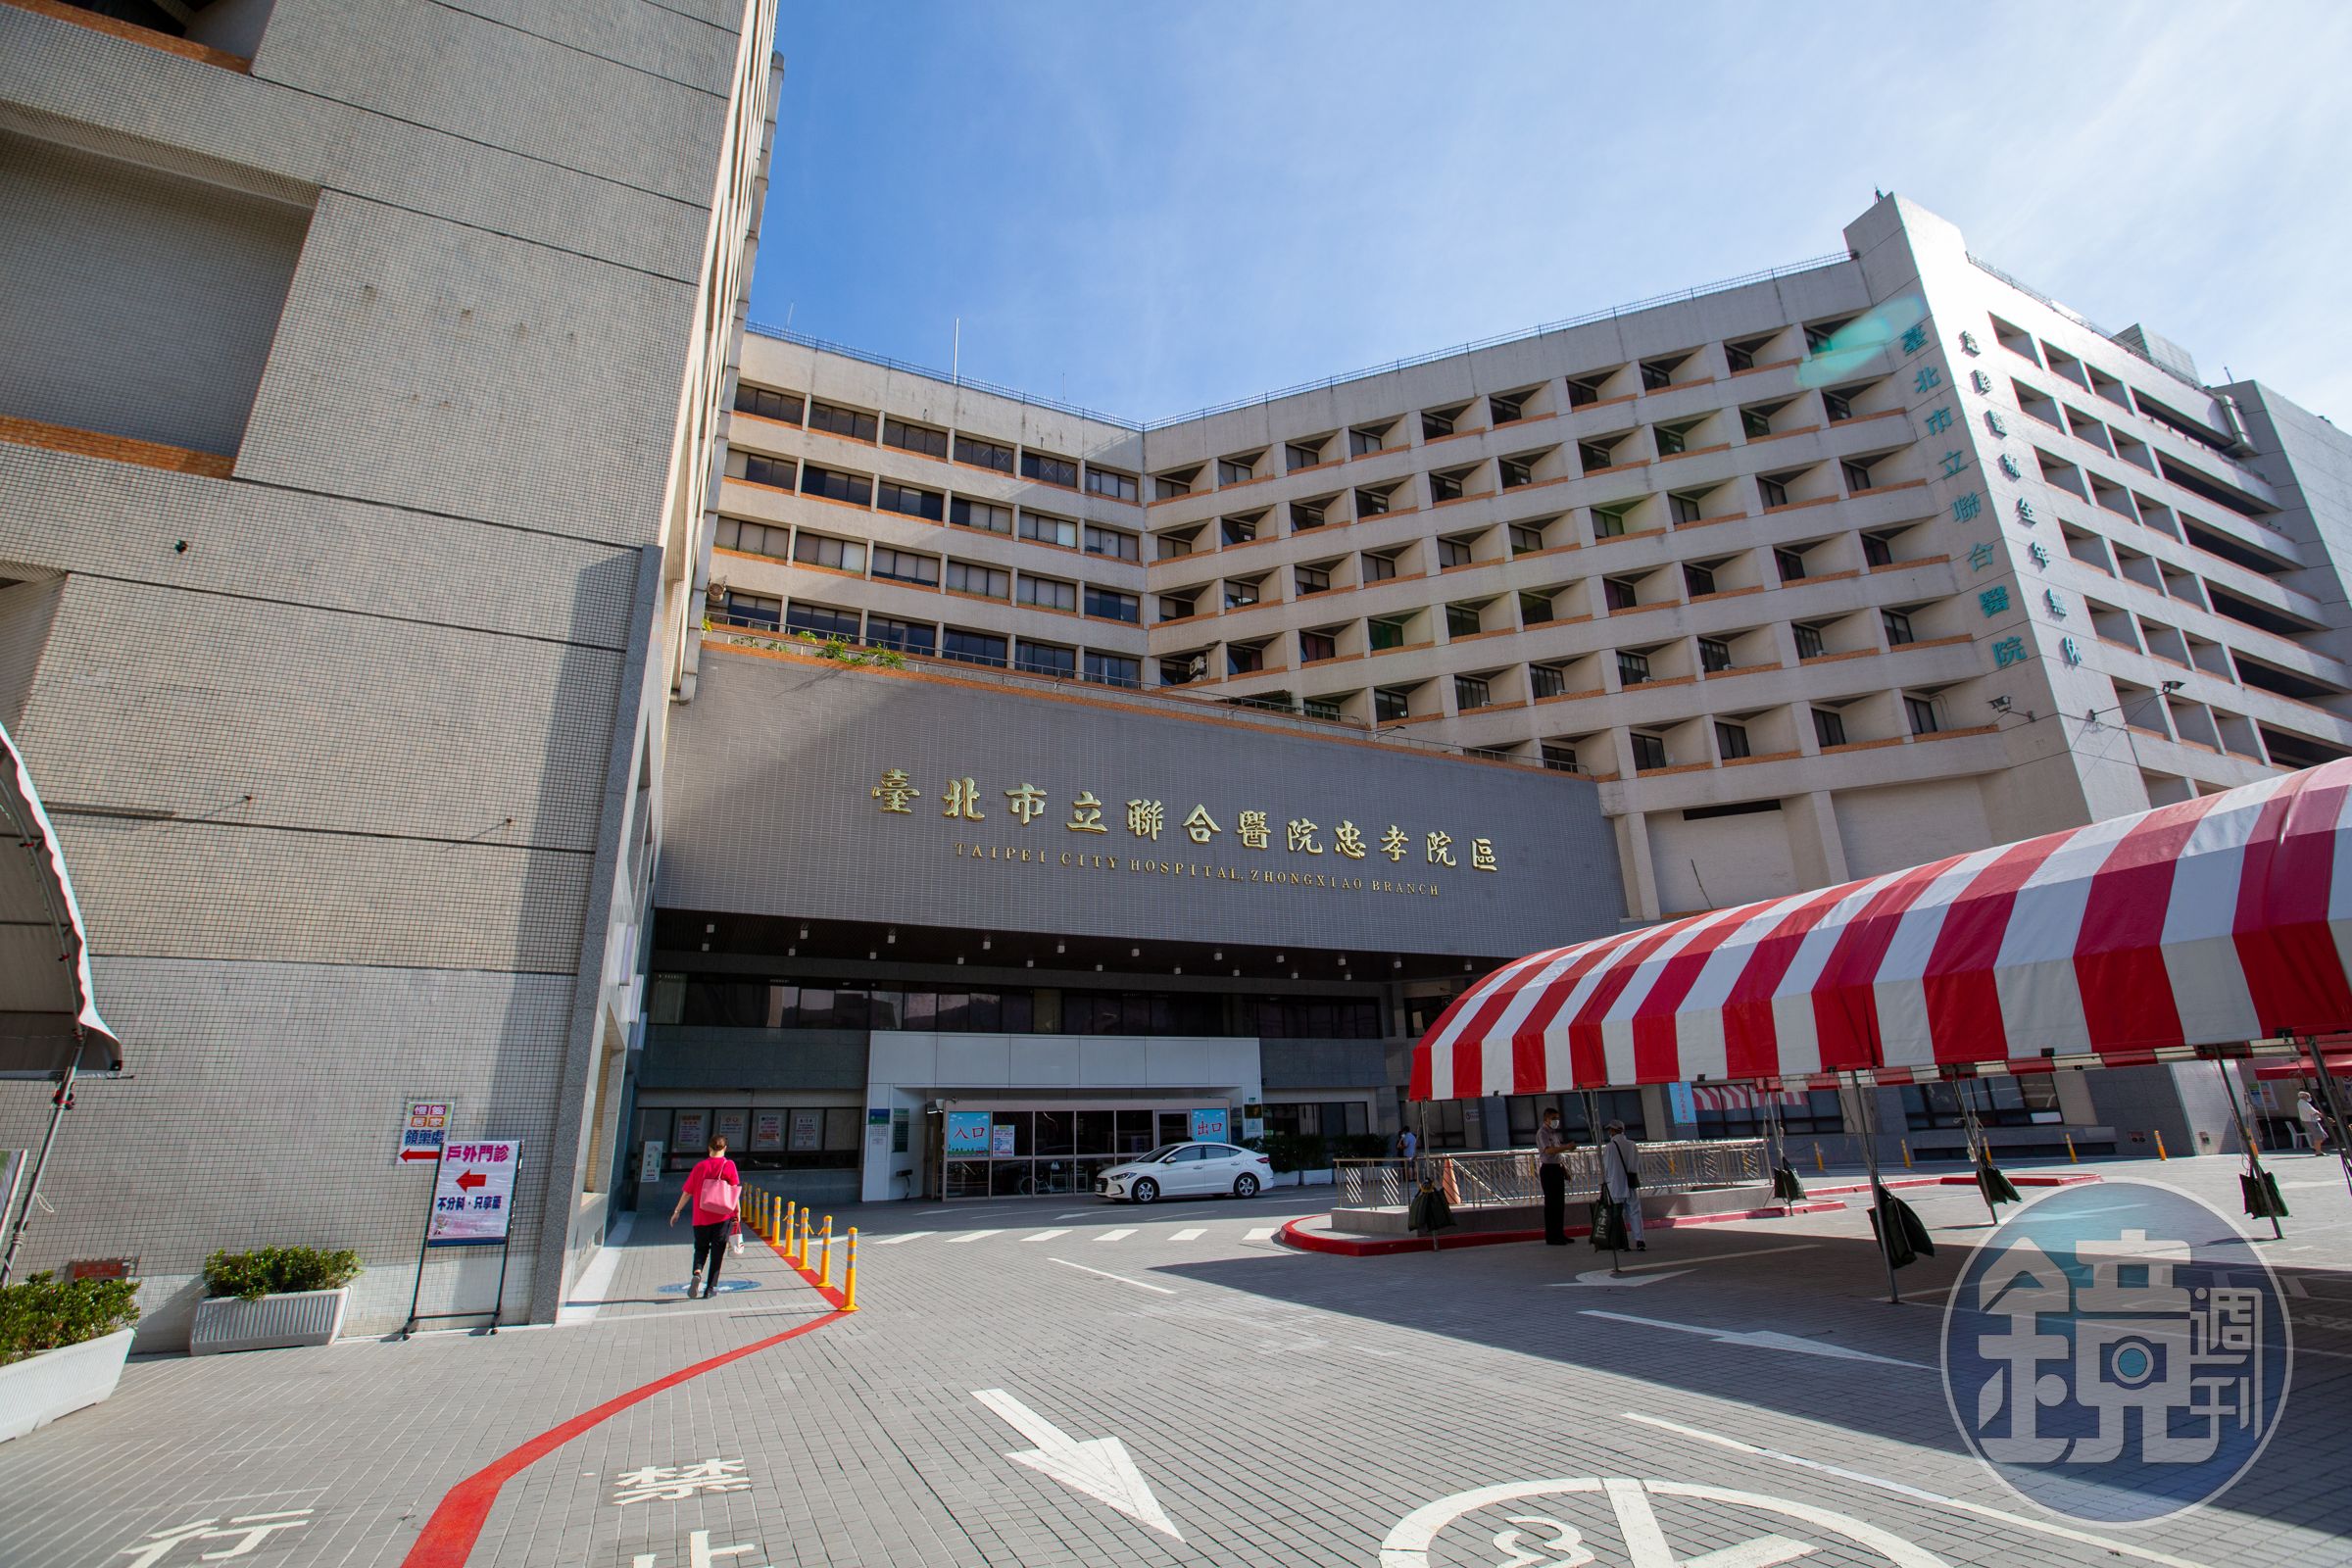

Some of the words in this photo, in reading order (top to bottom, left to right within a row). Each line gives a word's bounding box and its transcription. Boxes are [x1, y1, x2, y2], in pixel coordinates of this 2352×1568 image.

[1901, 324, 2028, 669] 臺北市立聯合醫院
[871, 767, 1497, 872] 臺北市立聯合醫院忠孝院區
[955, 843, 1046, 863] TAIPEI
[1060, 853, 1118, 870] CITY
[1250, 869, 1362, 890] ZHONGXIAO
[1372, 880, 1439, 896] BRANCH
[954, 1126, 985, 1140] 入口
[1198, 1120, 1223, 1136] 出口
